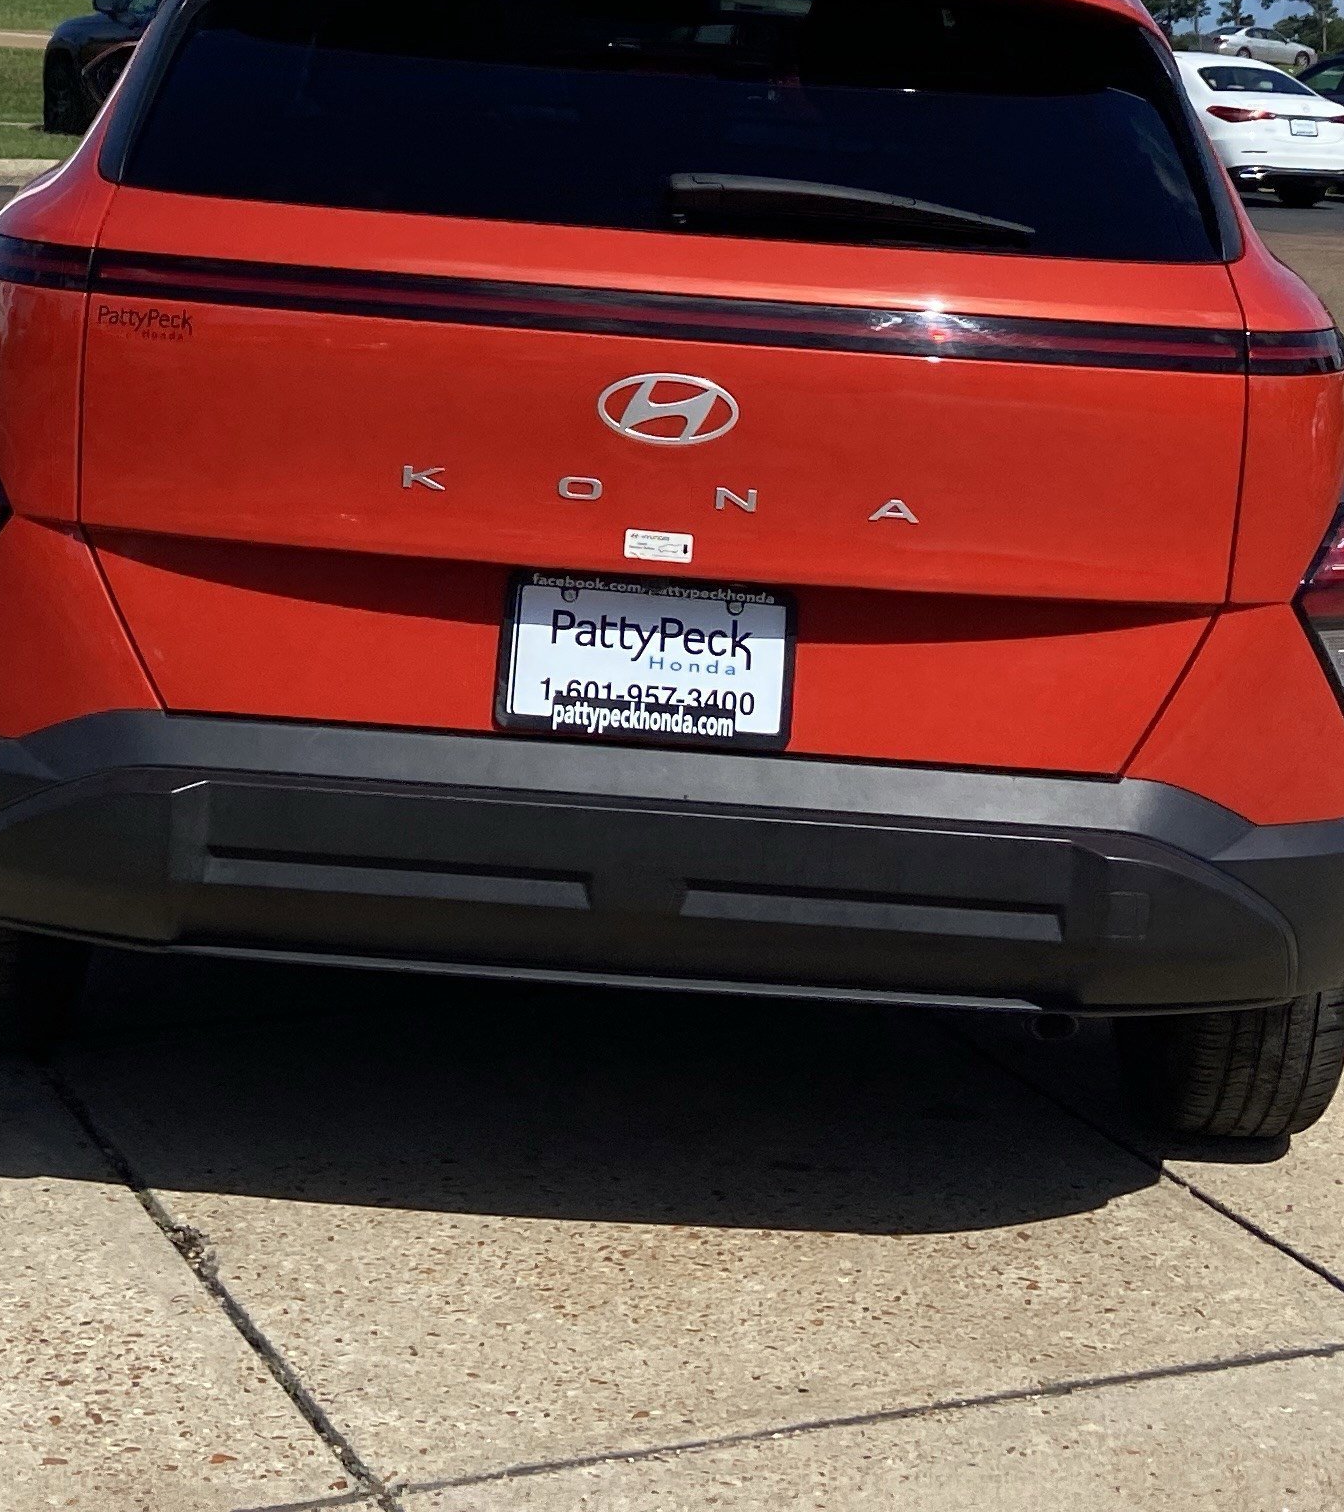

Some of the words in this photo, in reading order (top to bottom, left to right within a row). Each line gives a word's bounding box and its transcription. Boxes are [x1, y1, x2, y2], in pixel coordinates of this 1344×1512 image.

[97, 304, 194, 336] PattyPeck
[401, 464, 920, 525] KONA
[550, 608, 754, 671] PattyPeck
[648, 655, 737, 677] Honda
[540, 677, 756, 716] 1-601-957-3400
[551, 700, 735, 738] pattypeckhonda.com
